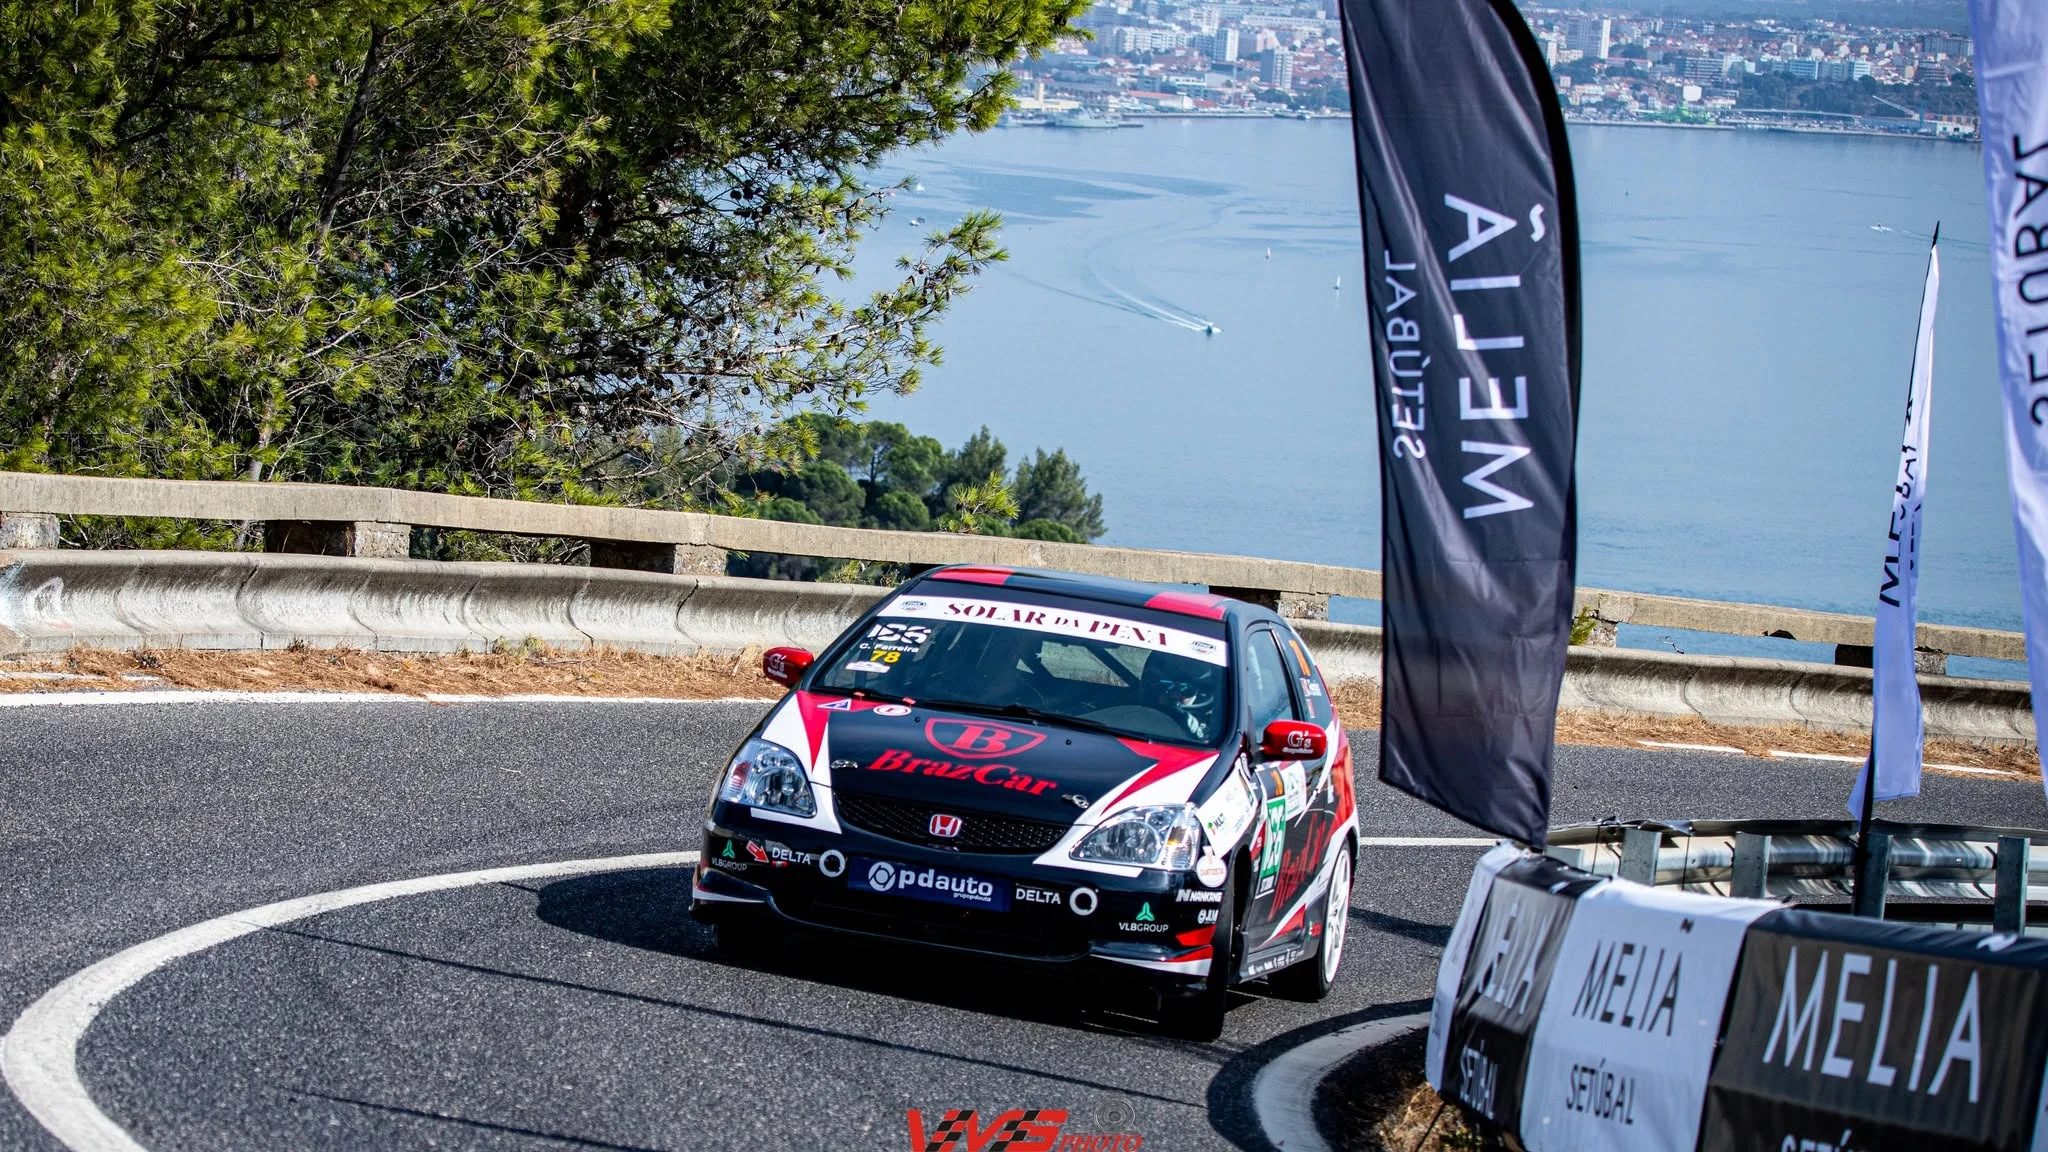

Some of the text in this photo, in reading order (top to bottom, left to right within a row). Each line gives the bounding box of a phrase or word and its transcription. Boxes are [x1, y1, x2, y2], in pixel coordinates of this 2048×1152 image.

[944, 602, 1047, 626] SOLAR
[1054, 616, 1080, 628] DA
[1088, 620, 1168, 646] PENA
[869, 649, 902, 664] 78
[873, 643, 920, 653] Ferreira
[943, 724, 1014, 753] B
[866, 749, 1058, 797] BrazCar
[711, 856, 748, 872] VLBGROUP
[771, 846, 812, 866] DELTA
[898, 868, 994, 898] pdauto
[1015, 887, 1062, 905] DELTA
[1118, 922, 1169, 933] VLBGROUP
[1565, 1057, 1637, 1126] SETÚBAL
